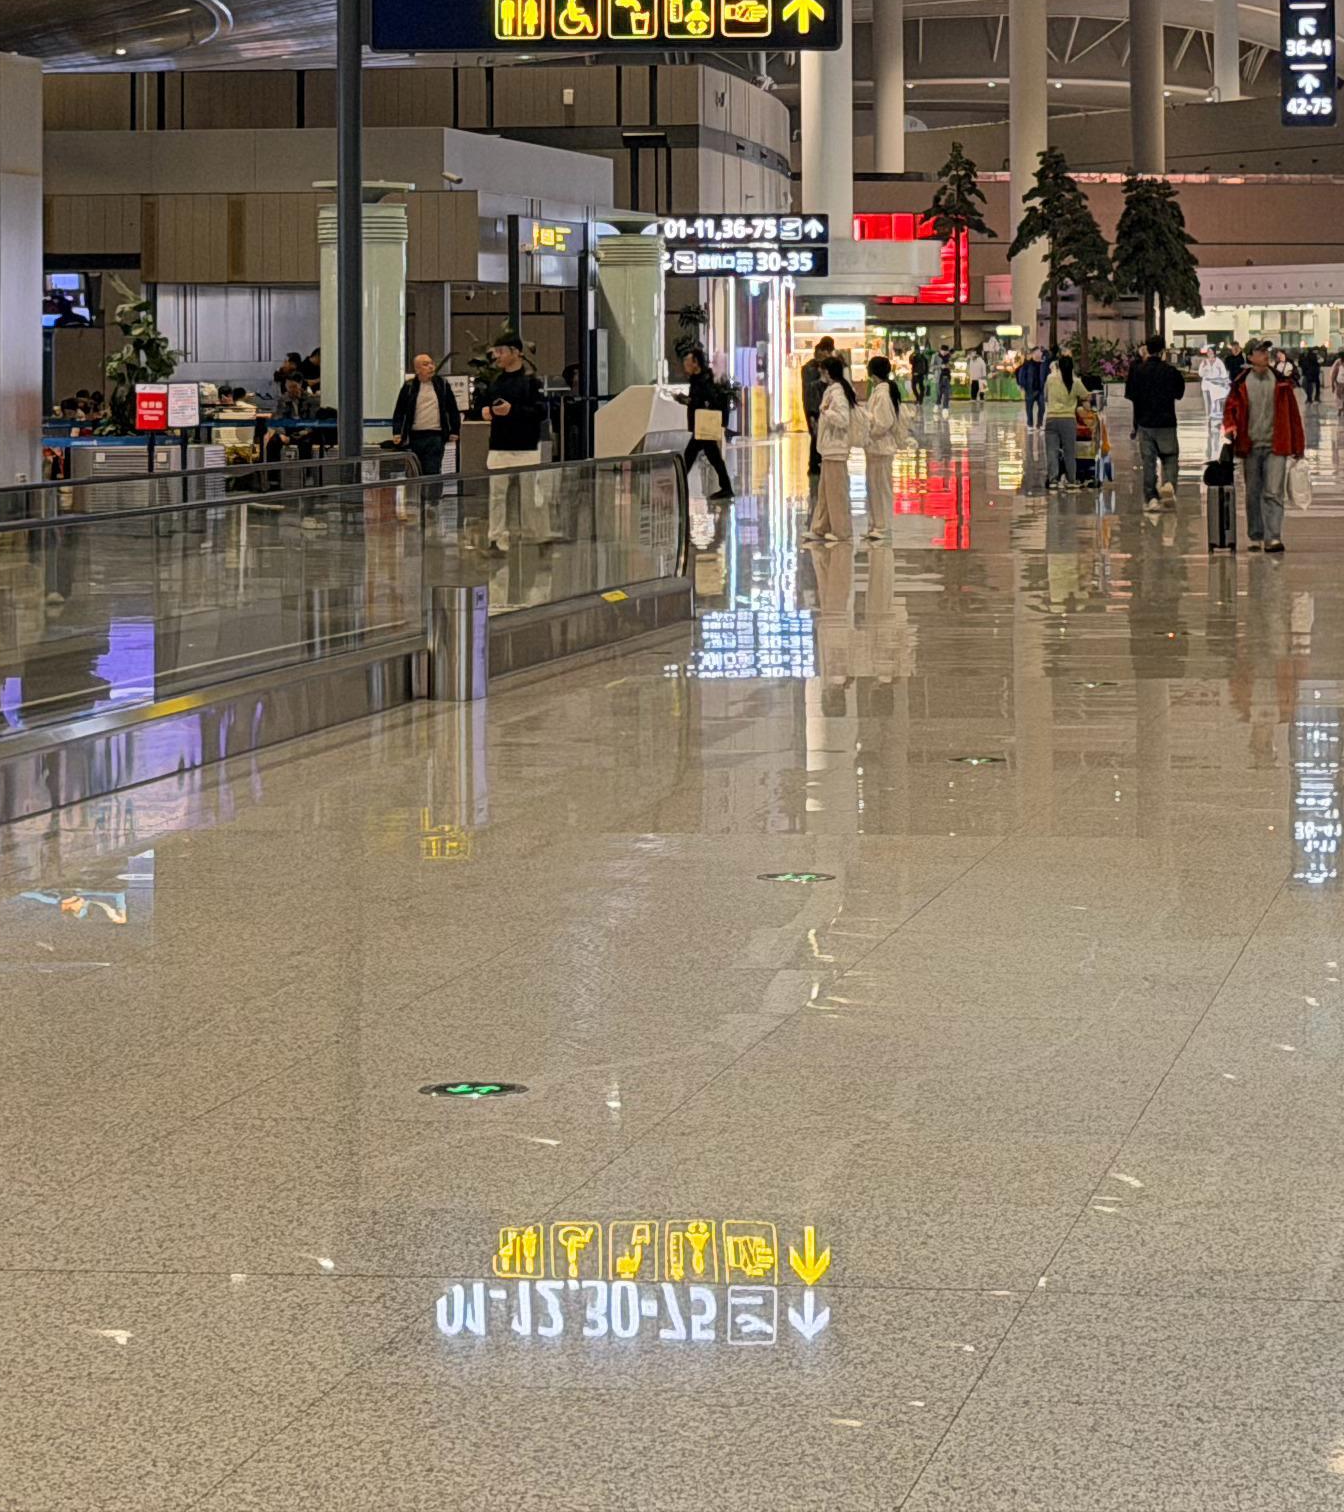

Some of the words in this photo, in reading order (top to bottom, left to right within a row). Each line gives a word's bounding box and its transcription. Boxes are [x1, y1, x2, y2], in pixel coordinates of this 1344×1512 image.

[1285, 39, 1332, 57] 36-41
[1286, 98, 1332, 115] 42-75
[663, 218, 777, 240] 01-11,36-75
[755, 251, 813, 271] 30-35
